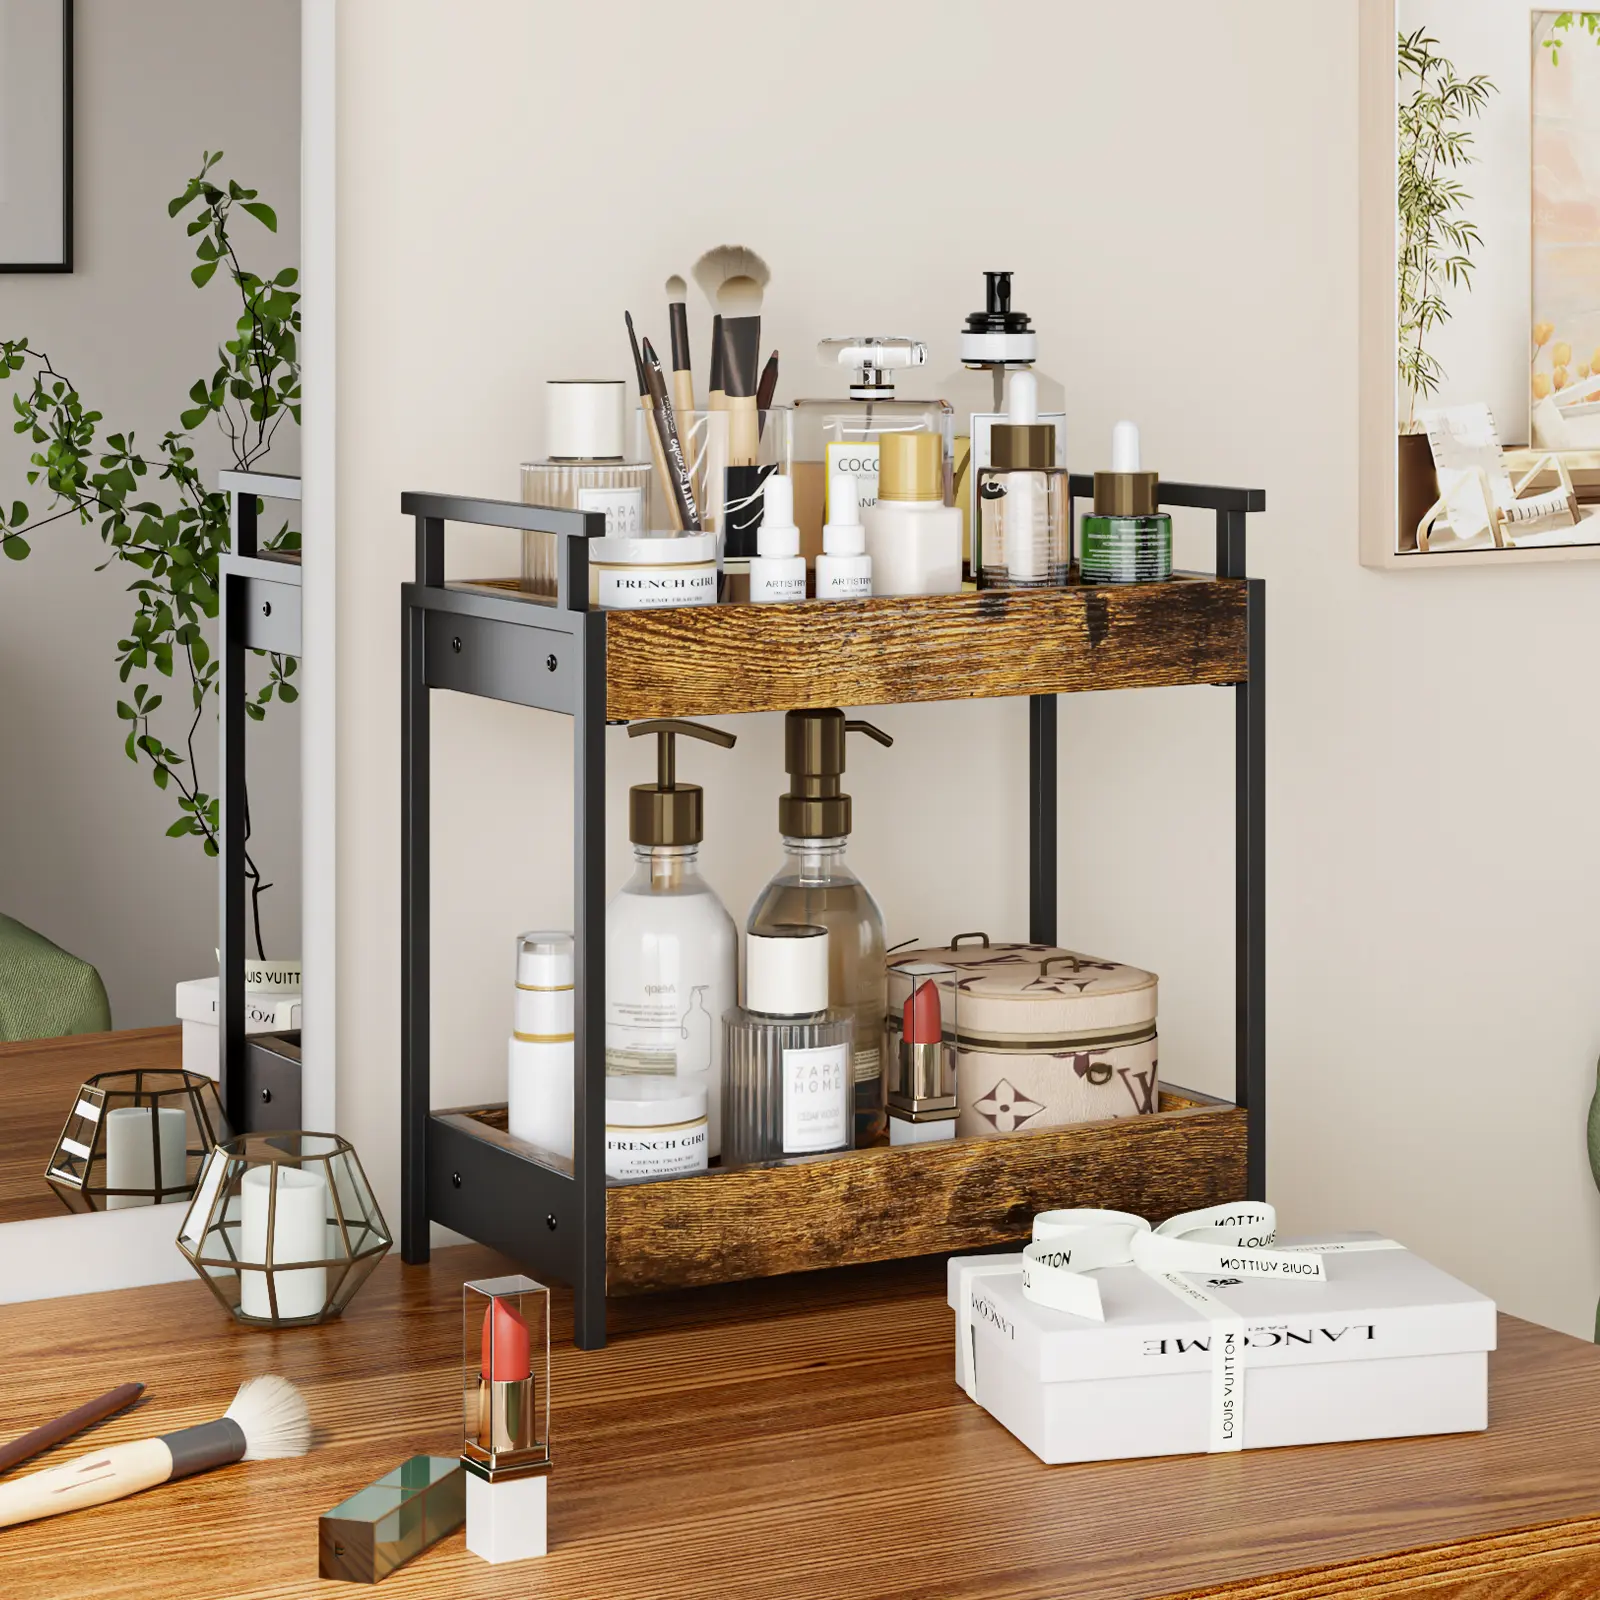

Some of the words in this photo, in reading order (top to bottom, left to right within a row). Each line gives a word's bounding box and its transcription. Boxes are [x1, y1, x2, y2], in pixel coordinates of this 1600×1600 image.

[605, 520, 638, 534] OME
[616, 579, 685, 589] FRENCH
[690, 576, 714, 588] GIRL
[265, 971, 301, 984] VUITT
[795, 1063, 841, 1079] ZARA
[794, 1077, 842, 1094] HOME
[608, 1140, 676, 1151] FRENCH
[681, 1132, 704, 1147] GIRL
[1143, 1325, 1376, 1356] LANCME
[1223, 1333, 1235, 1397] VUITTON
[1222, 1400, 1234, 1439] LOUIS
